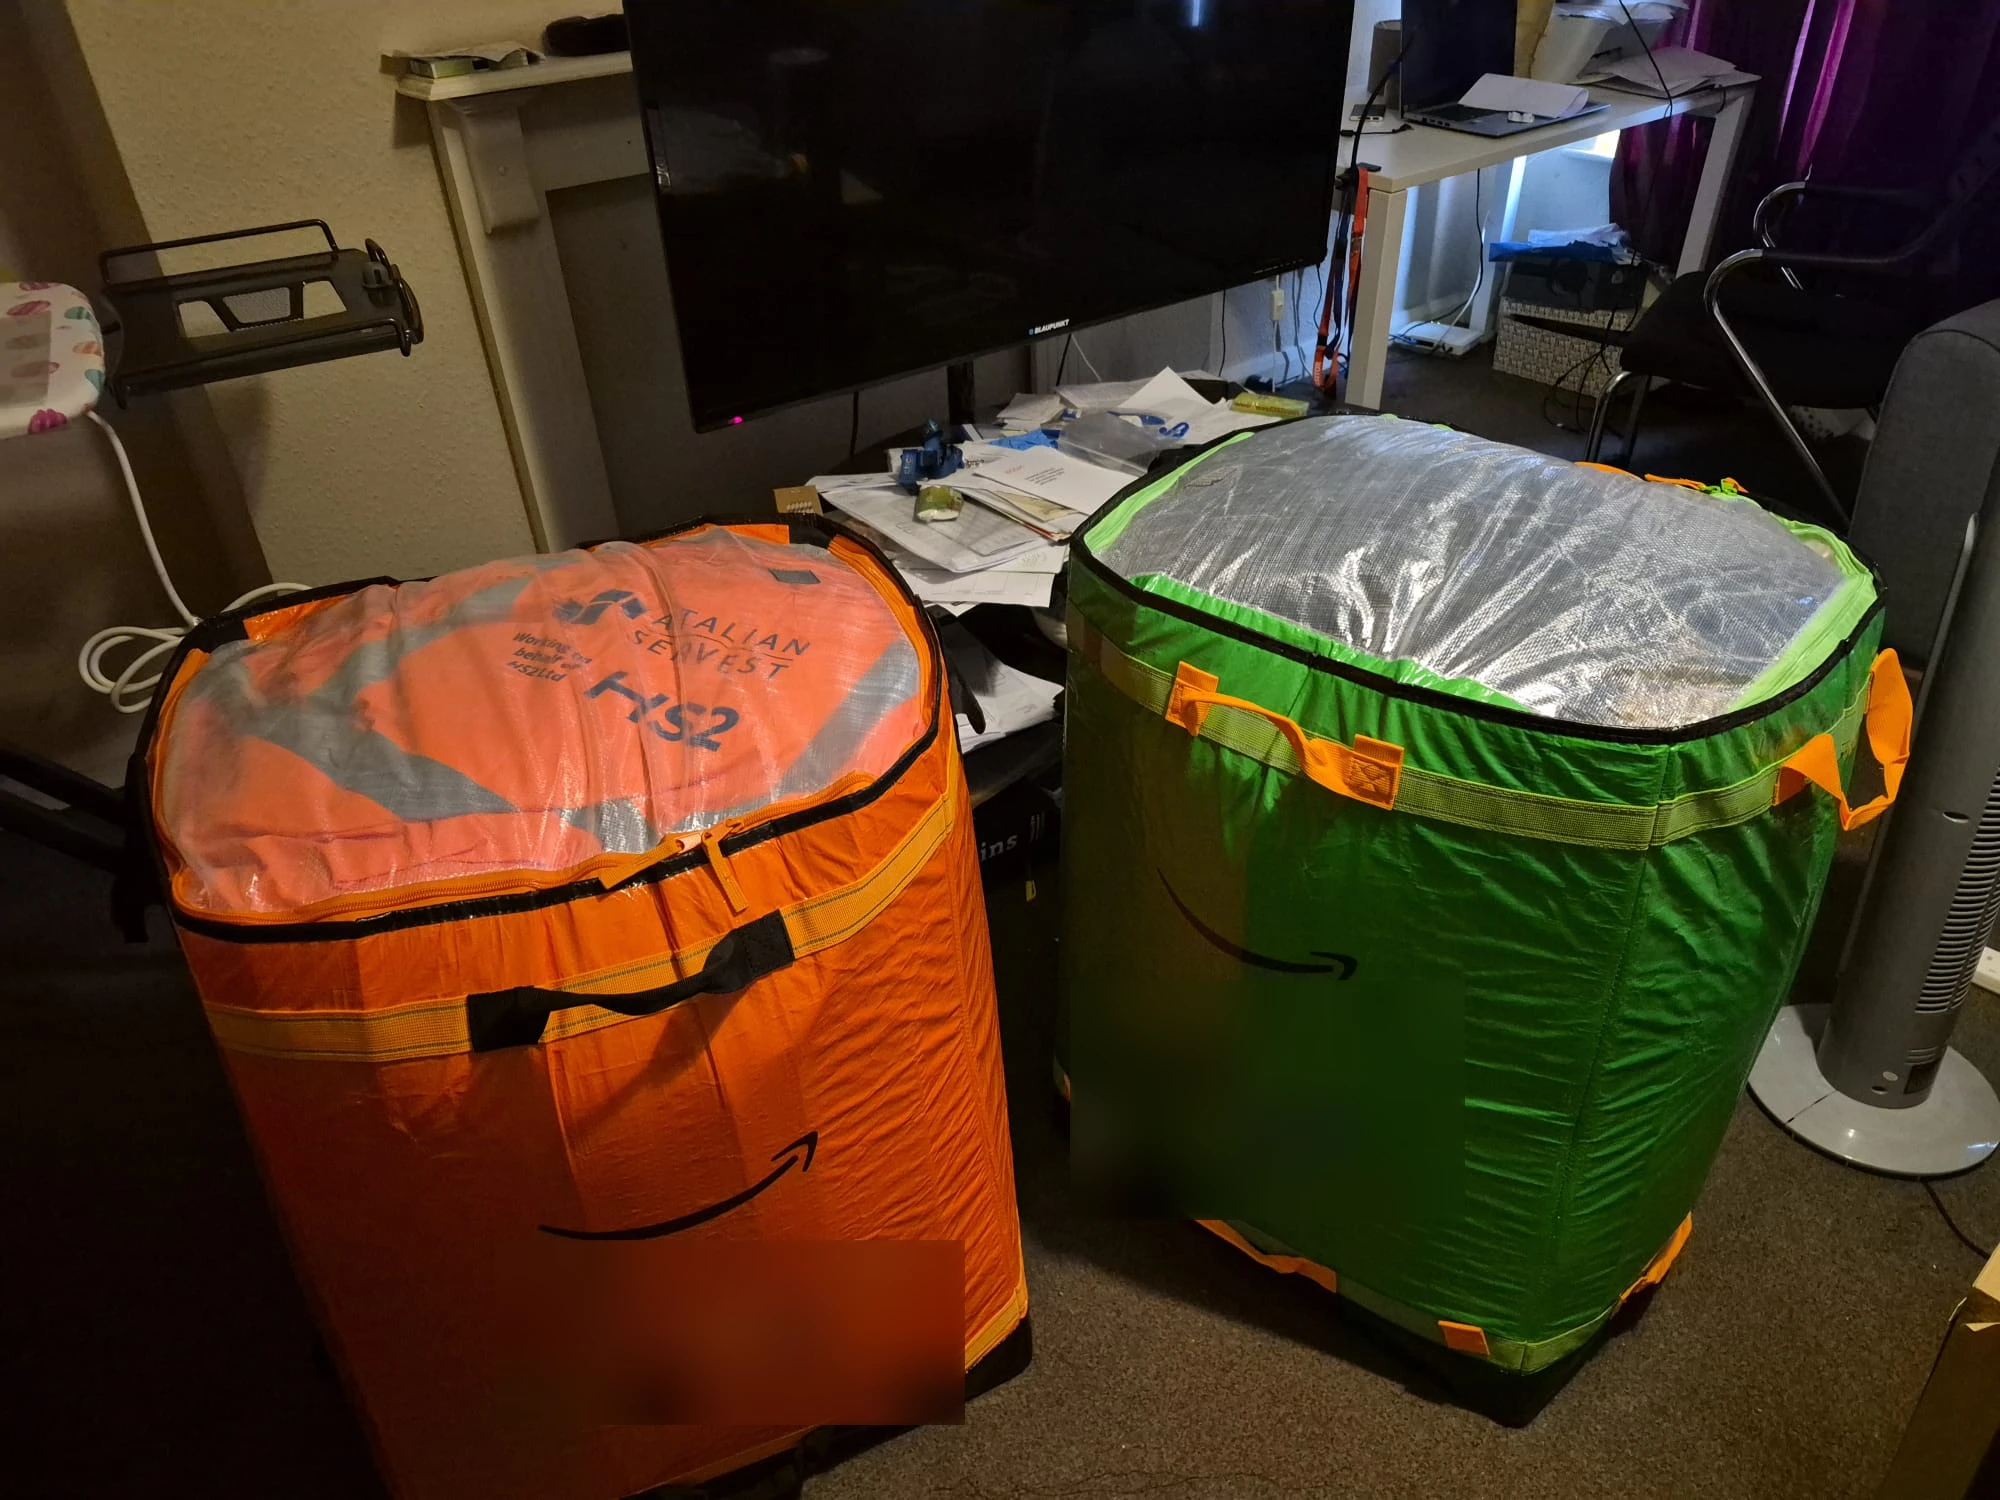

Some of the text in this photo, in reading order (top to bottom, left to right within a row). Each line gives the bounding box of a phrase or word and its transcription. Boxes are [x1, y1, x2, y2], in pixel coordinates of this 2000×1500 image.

[1034, 318, 1070, 335] BLAUPUNKT
[512, 632, 571, 654] Working
[653, 608, 811, 656] ATALIAN
[585, 670, 740, 752] HS2
[980, 834, 1019, 862] ins
